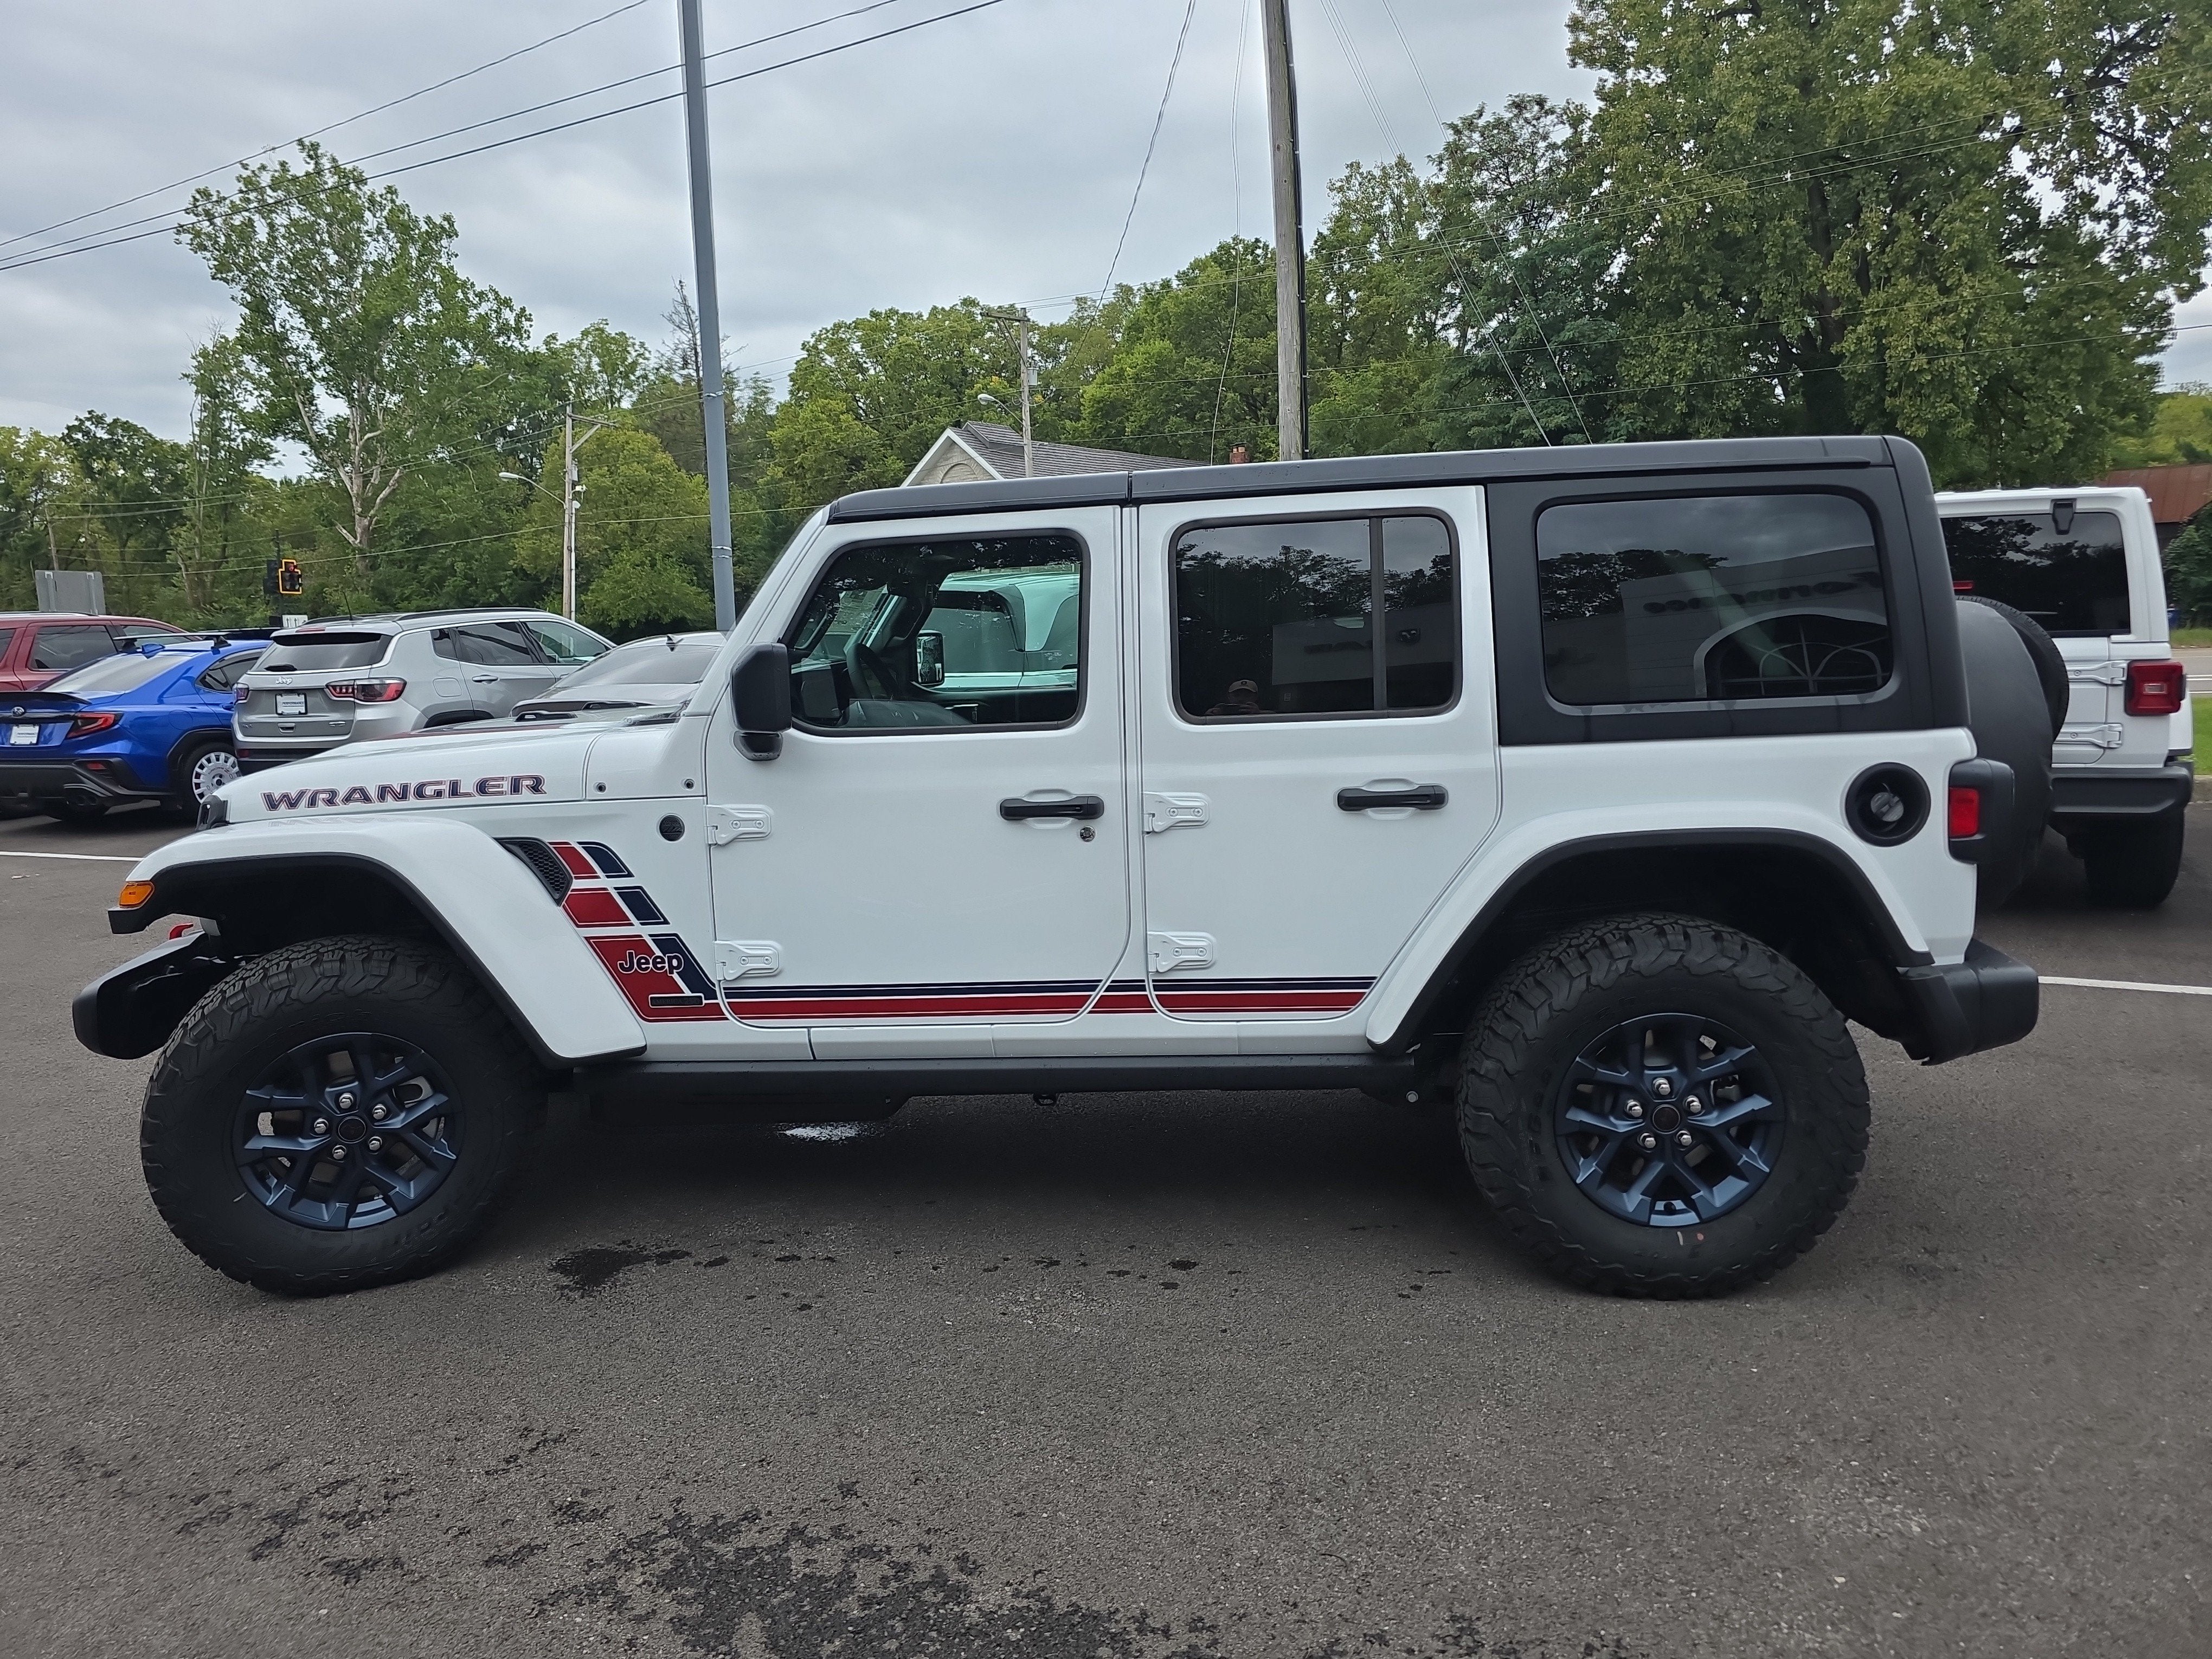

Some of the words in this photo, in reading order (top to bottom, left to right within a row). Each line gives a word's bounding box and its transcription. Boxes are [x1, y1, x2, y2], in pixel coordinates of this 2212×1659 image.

[275, 676, 293, 685] Jeep
[261, 775, 546, 811] WRANGLER
[617, 950, 684, 976] Jeep
